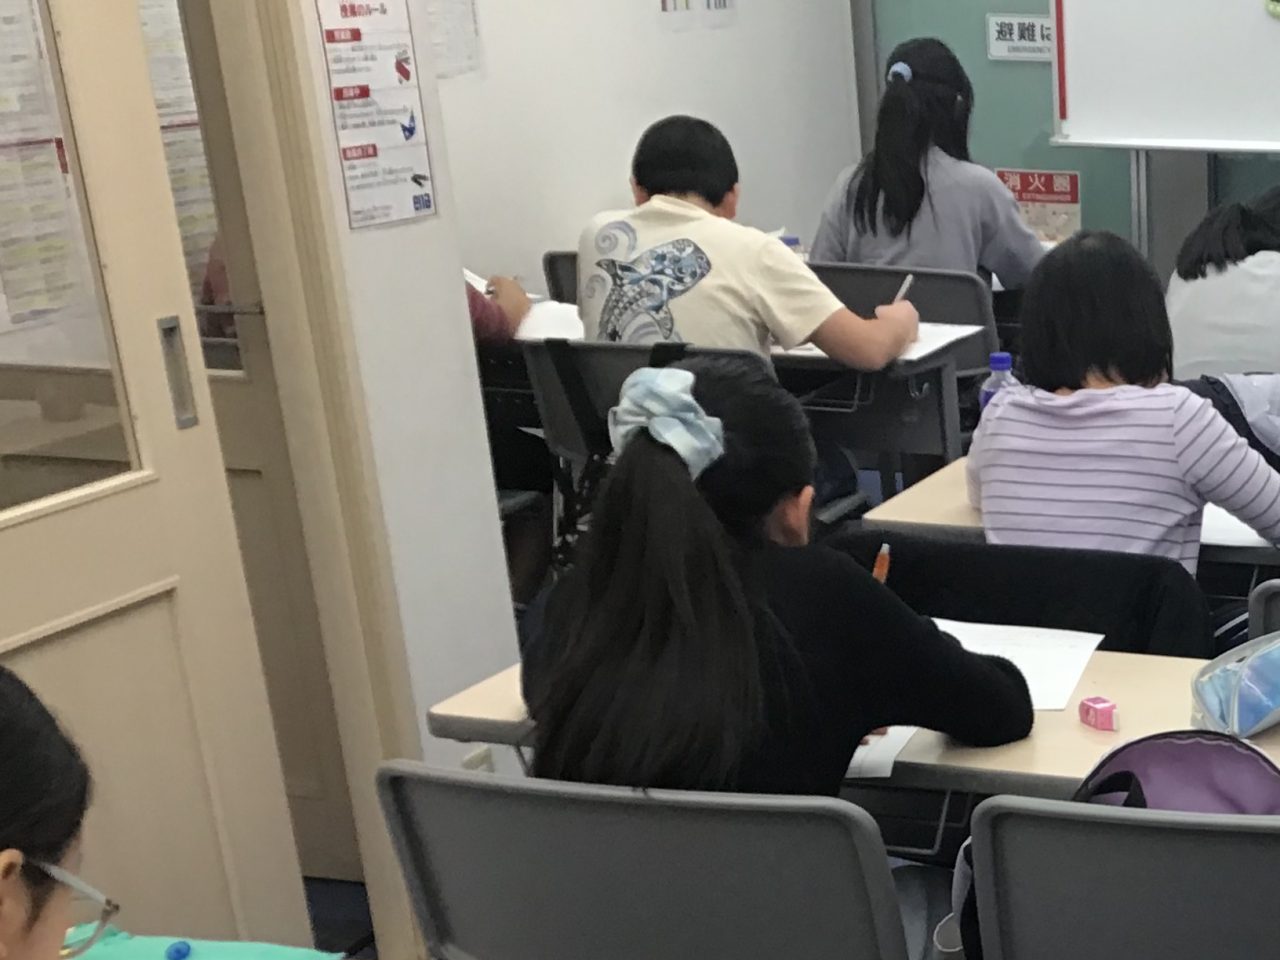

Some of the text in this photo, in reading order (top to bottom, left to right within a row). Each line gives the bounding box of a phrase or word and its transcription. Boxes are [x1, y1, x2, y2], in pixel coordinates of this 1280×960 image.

[1003, 172, 1070, 192] 消火器
[412, 193, 432, 211] ena
